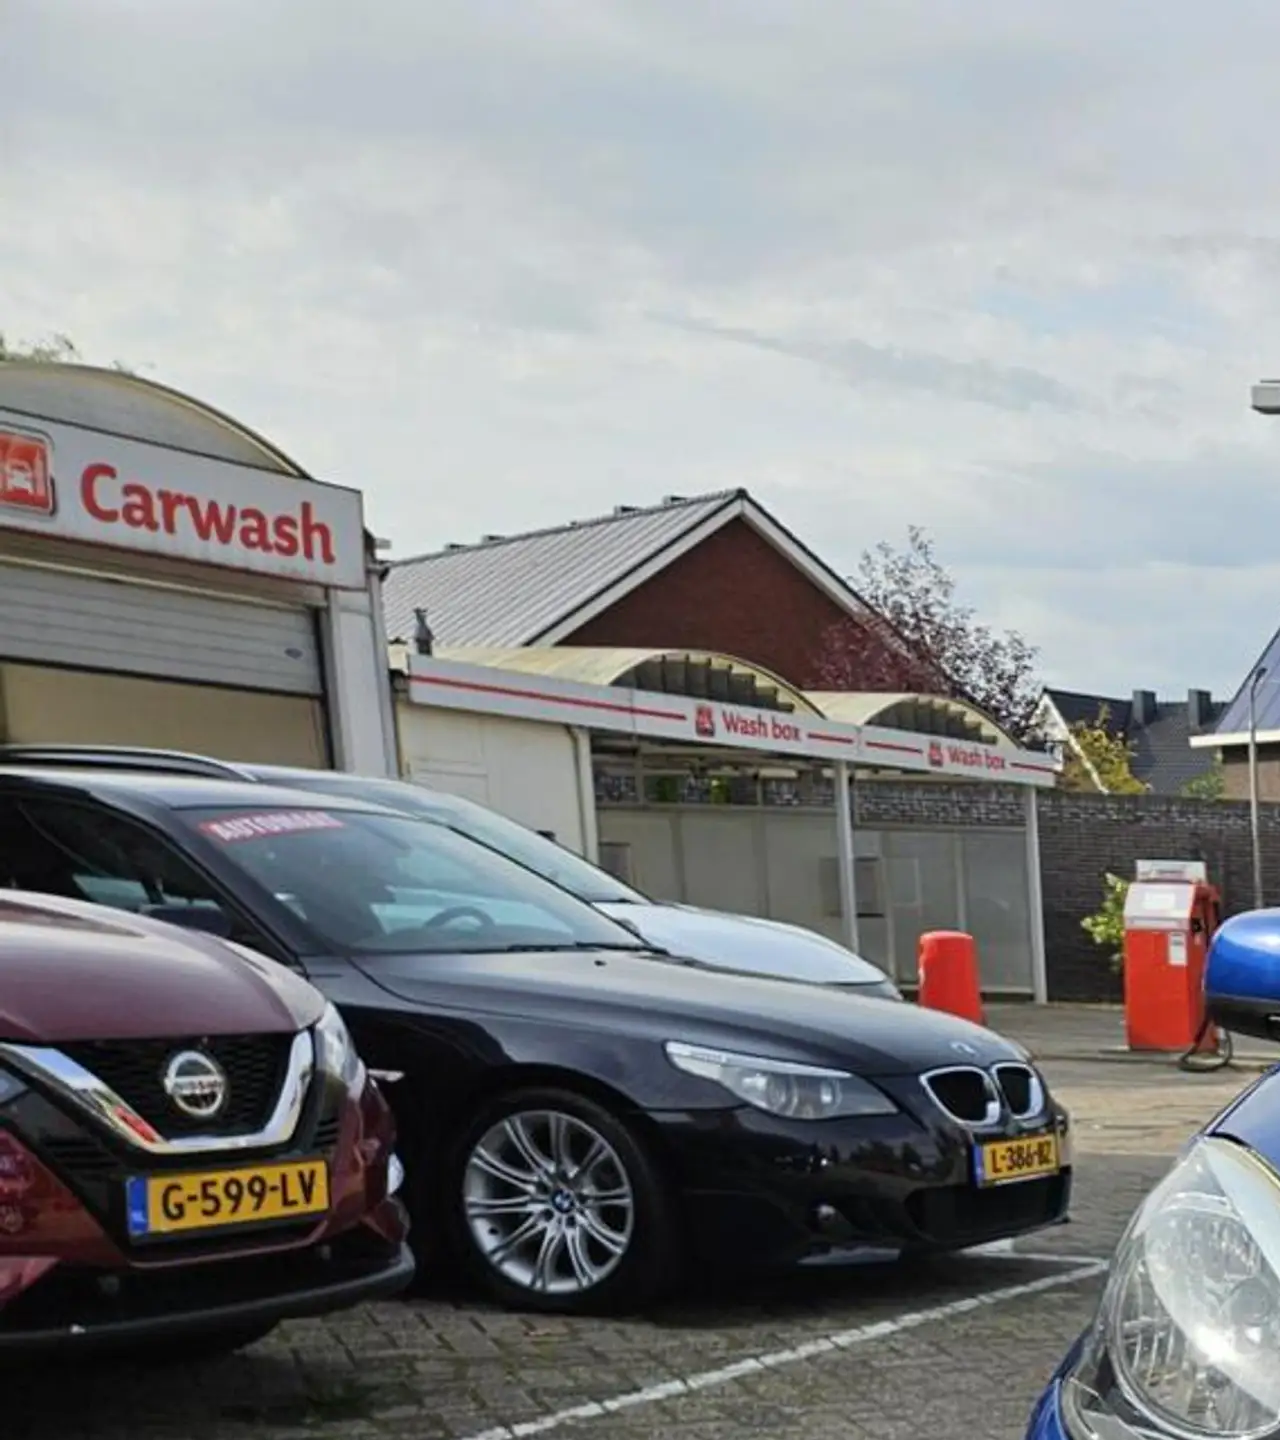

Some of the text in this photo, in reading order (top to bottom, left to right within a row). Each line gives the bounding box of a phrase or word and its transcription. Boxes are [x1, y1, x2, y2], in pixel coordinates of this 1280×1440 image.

[80, 463, 336, 564] Carwash
[721, 711, 800, 741] Wash box
[949, 746, 1006, 770] Wash box
[162, 1169, 316, 1220] G-599-LV
